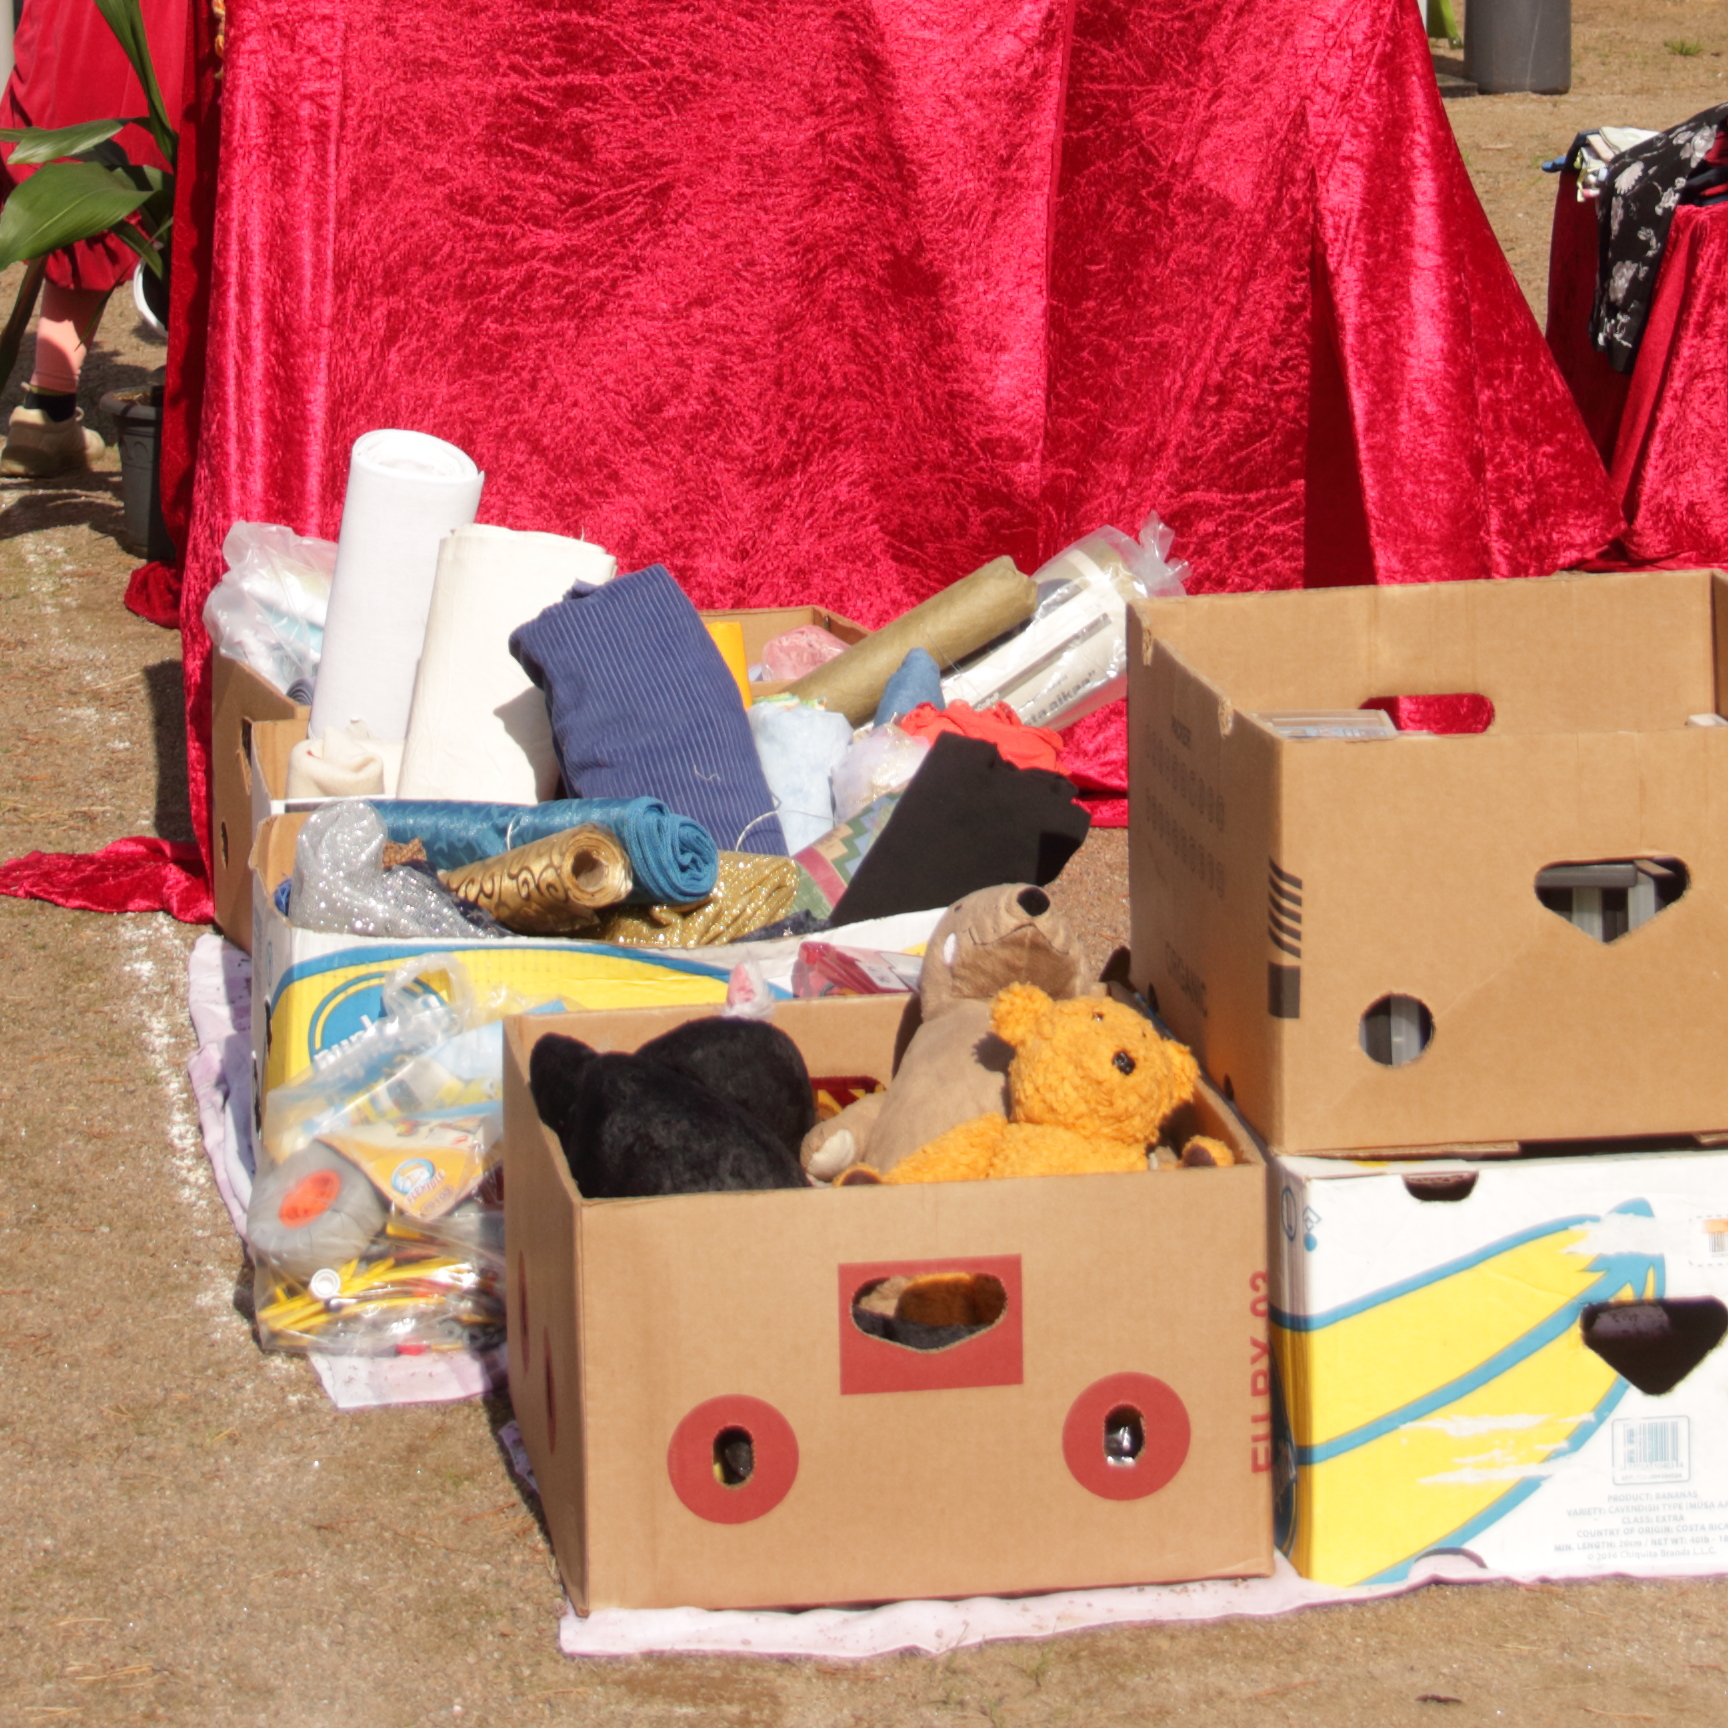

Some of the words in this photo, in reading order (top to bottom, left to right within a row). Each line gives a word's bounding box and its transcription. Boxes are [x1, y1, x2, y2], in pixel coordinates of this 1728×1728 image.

[1608, 1493, 1652, 1503] PRODUCT:
[1655, 1490, 1697, 1500] BANANAS
[1567, 1506, 1606, 1516] VARIETY:
[1609, 1504, 1659, 1514] CAVENDISH
[1662, 1503, 1682, 1512] TYPE
[1686, 1501, 1715, 1512] (MUSA
[1622, 1515, 1653, 1525] CLASS:
[1656, 1513, 1684, 1523] EXTRA
[1577, 1528, 1620, 1537] COUNTRY
[1623, 1527, 1635, 1535] OF
[1638, 1525, 1673, 1535] ORIGIN:
[1676, 1524, 1705, 1533] COSTA
[1709, 1522, 1728, 1531] RICA
